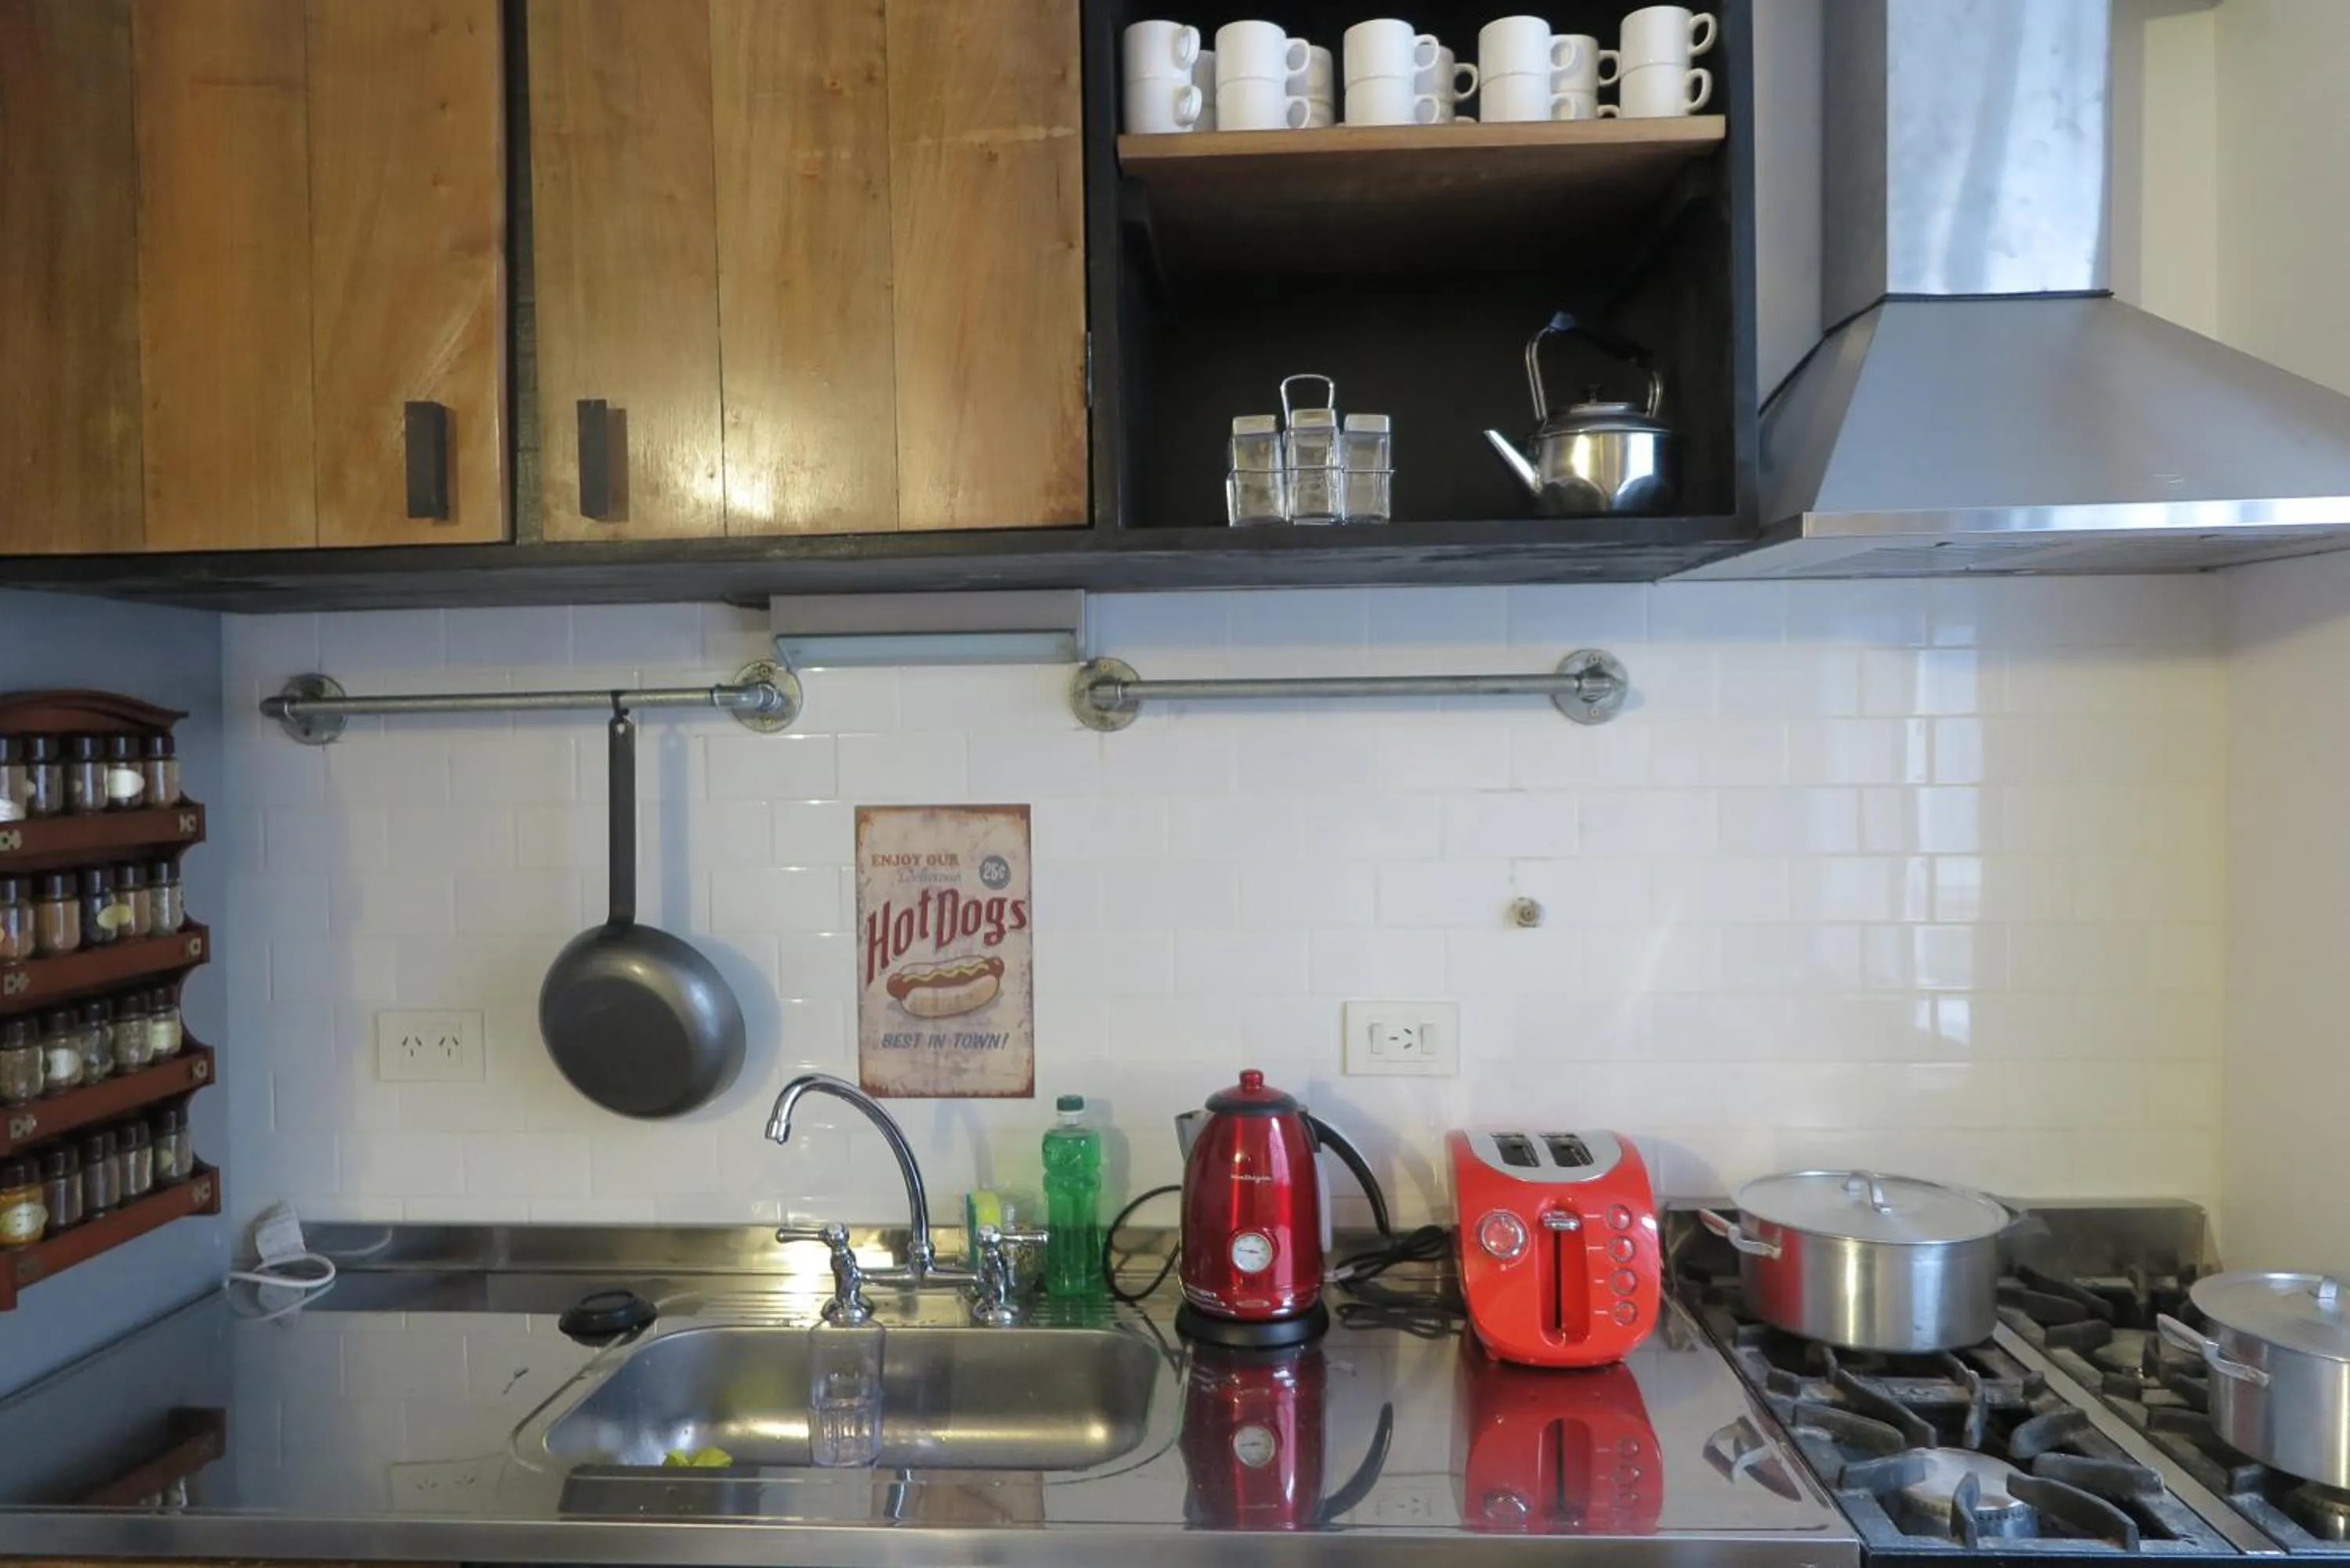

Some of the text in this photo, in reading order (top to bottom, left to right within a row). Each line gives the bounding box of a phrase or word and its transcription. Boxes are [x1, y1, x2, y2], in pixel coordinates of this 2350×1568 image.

[871, 853, 960, 867] ENJOY OUR
[867, 887, 1027, 986] Hot Dogs
[881, 1032, 1010, 1050] BEST IN TOWN!
